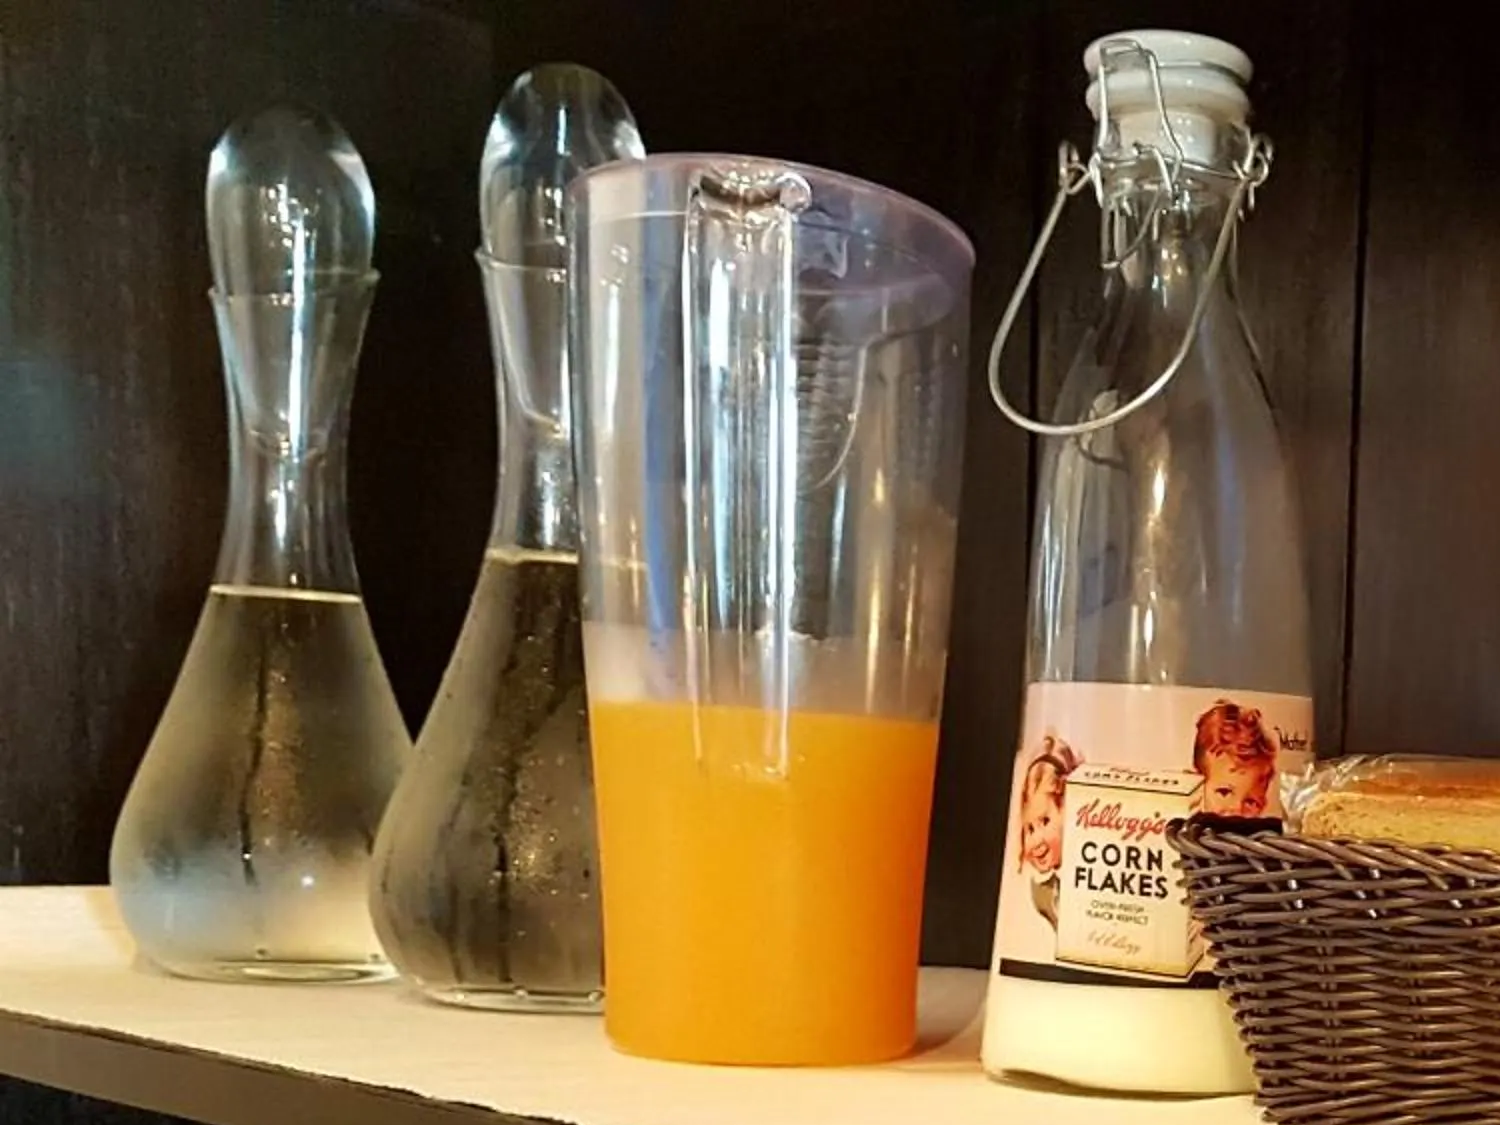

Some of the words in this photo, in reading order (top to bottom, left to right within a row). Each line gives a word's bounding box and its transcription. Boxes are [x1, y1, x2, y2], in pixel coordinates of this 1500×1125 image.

[1075, 797, 1166, 841] Kellogg's
[1081, 840, 1163, 872] CORN
[1074, 865, 1169, 899] FLAKES
